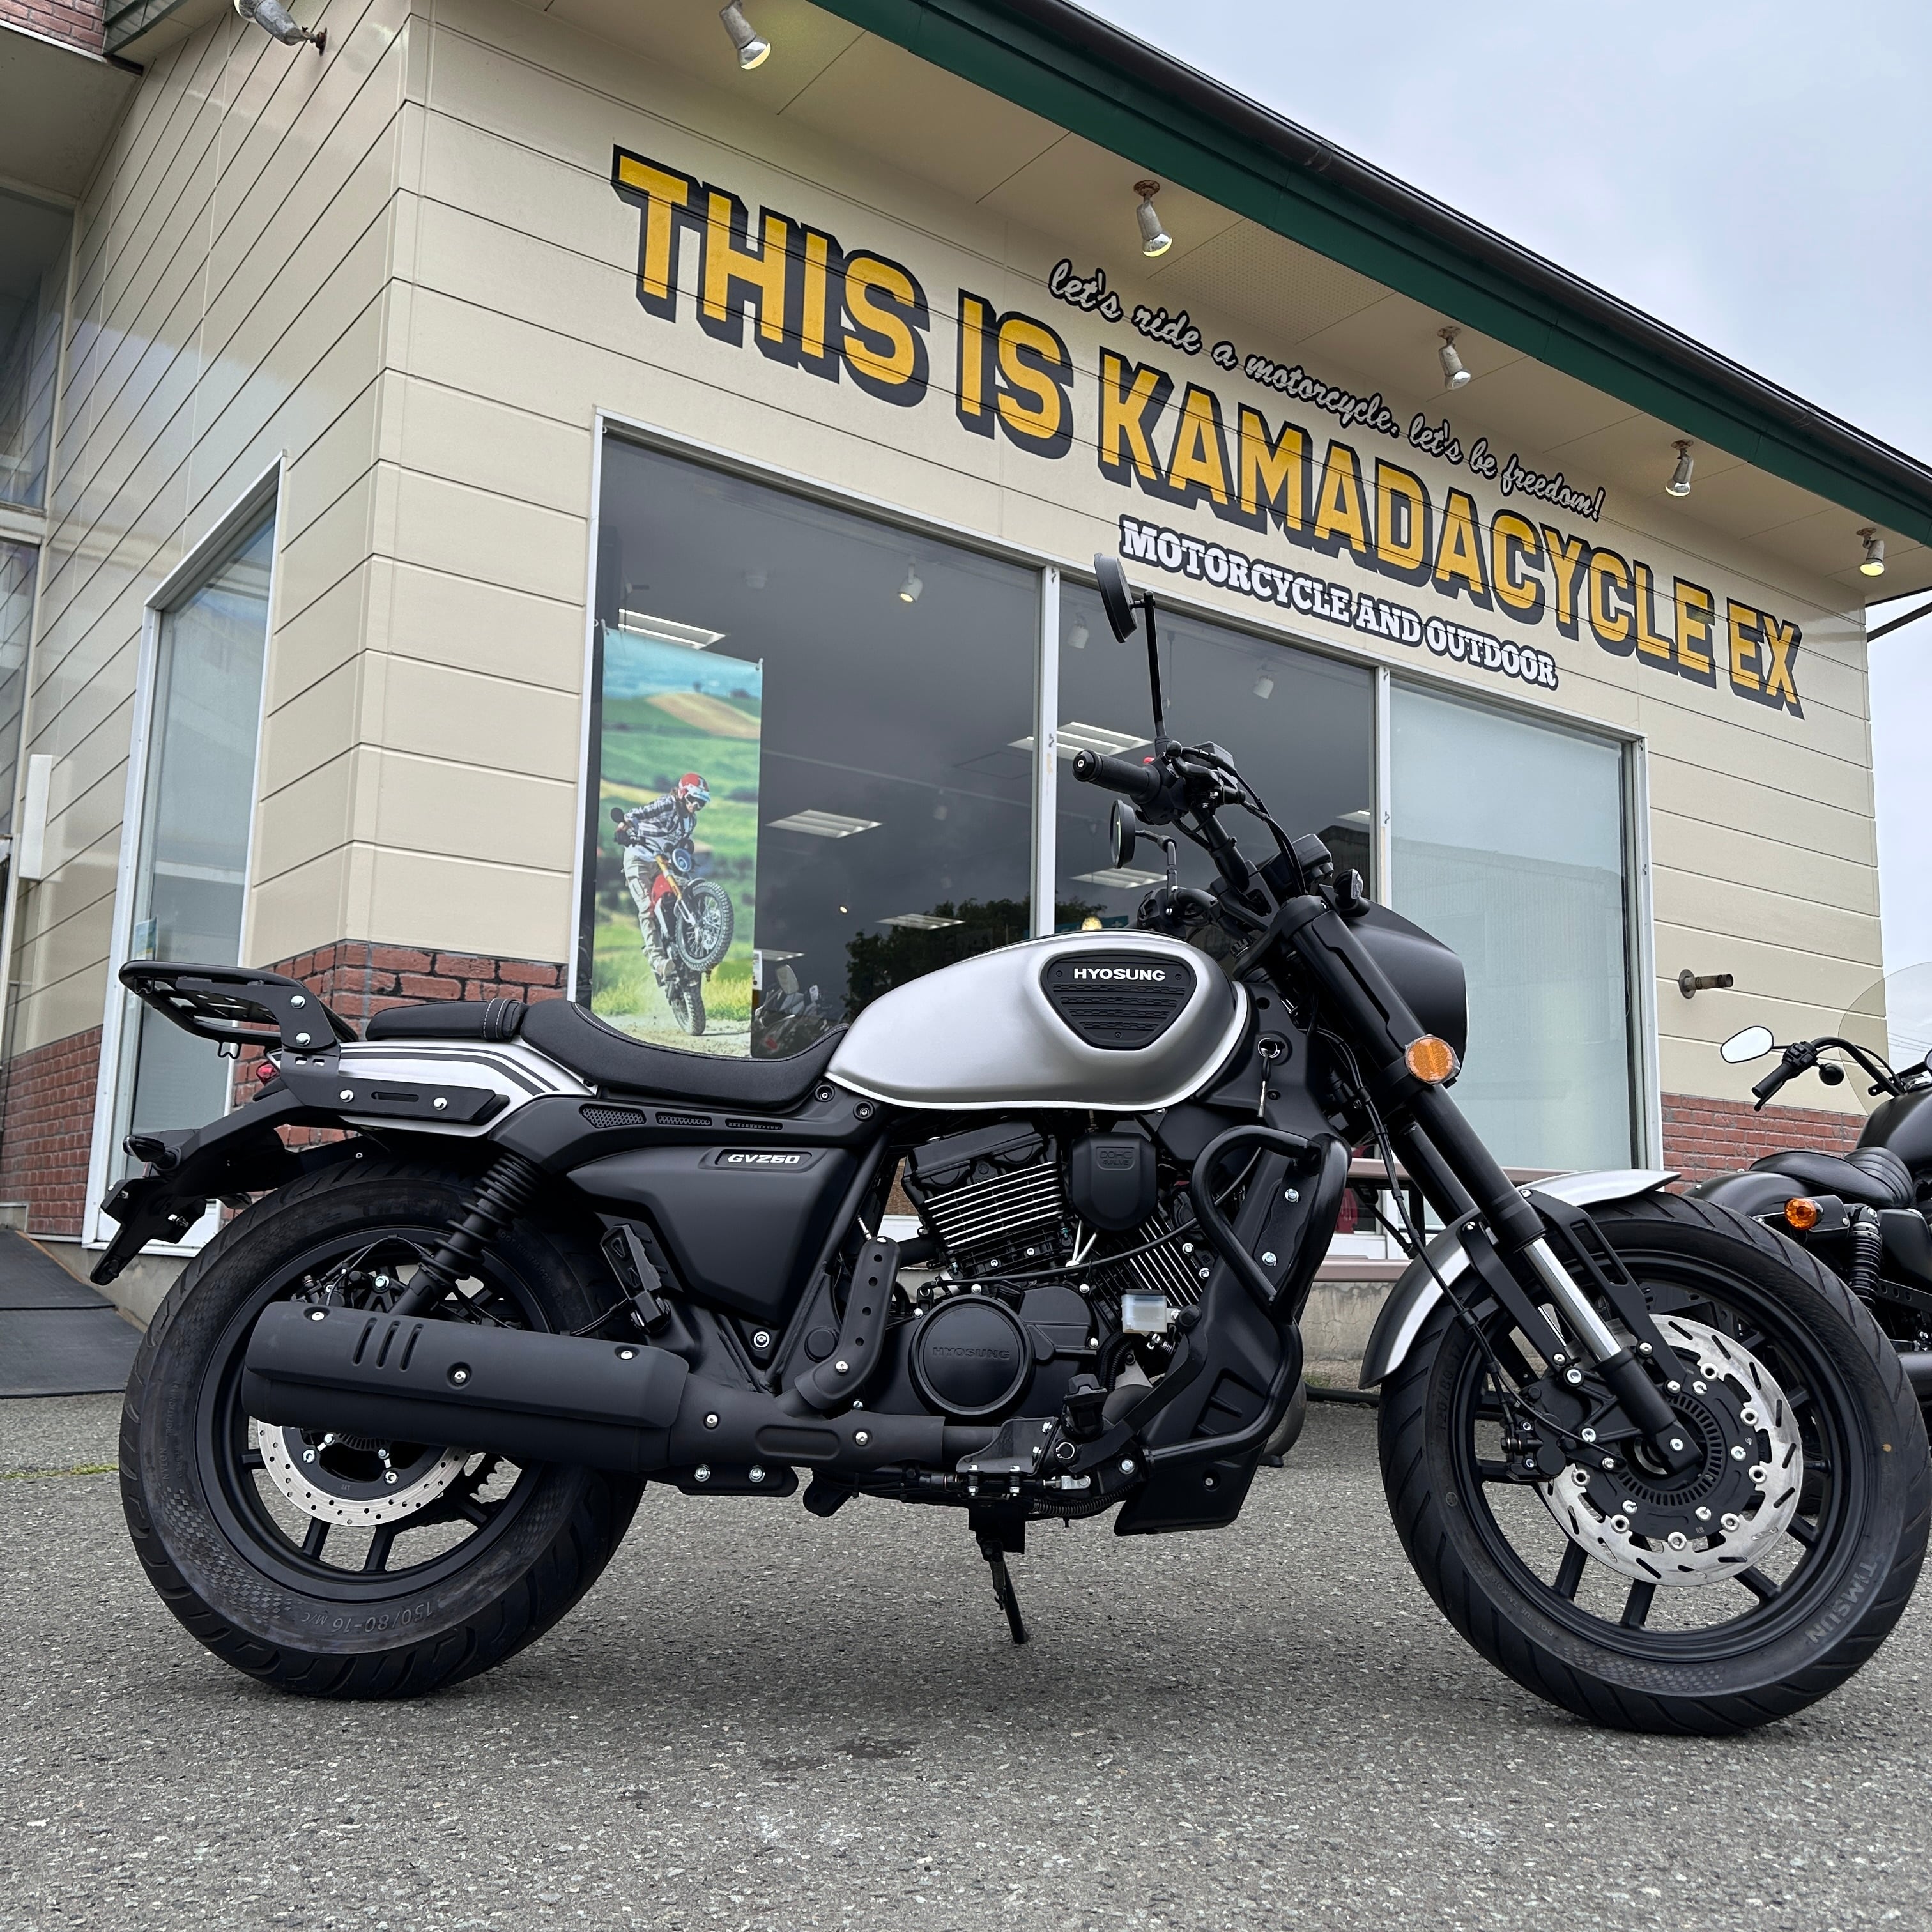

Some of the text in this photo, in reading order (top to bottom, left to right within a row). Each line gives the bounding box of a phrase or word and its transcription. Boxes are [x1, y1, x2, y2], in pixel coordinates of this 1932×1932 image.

[1048, 258, 1123, 323] let's
[1131, 305, 1202, 356] ride
[1211, 341, 1238, 371] a
[1407, 412, 1464, 465] let's
[1469, 437, 1498, 480] be
[1500, 452, 1606, 523] freedom!
[611, 144, 1805, 720] THIS IS KAMADACYCLE EX
[1119, 514, 1559, 691] MOTORCYCLE AND OUTDOOR
[1074, 967, 1167, 982] HYOSUNG
[728, 1154, 801, 1163] GV250
[933, 1347, 1010, 1360] HYOSUNG
[160, 1447, 169, 1480] NYLON
[300, 1601, 433, 1634] 150/80-16 M/C
[1804, 1561, 1878, 1644] TIMSUN
